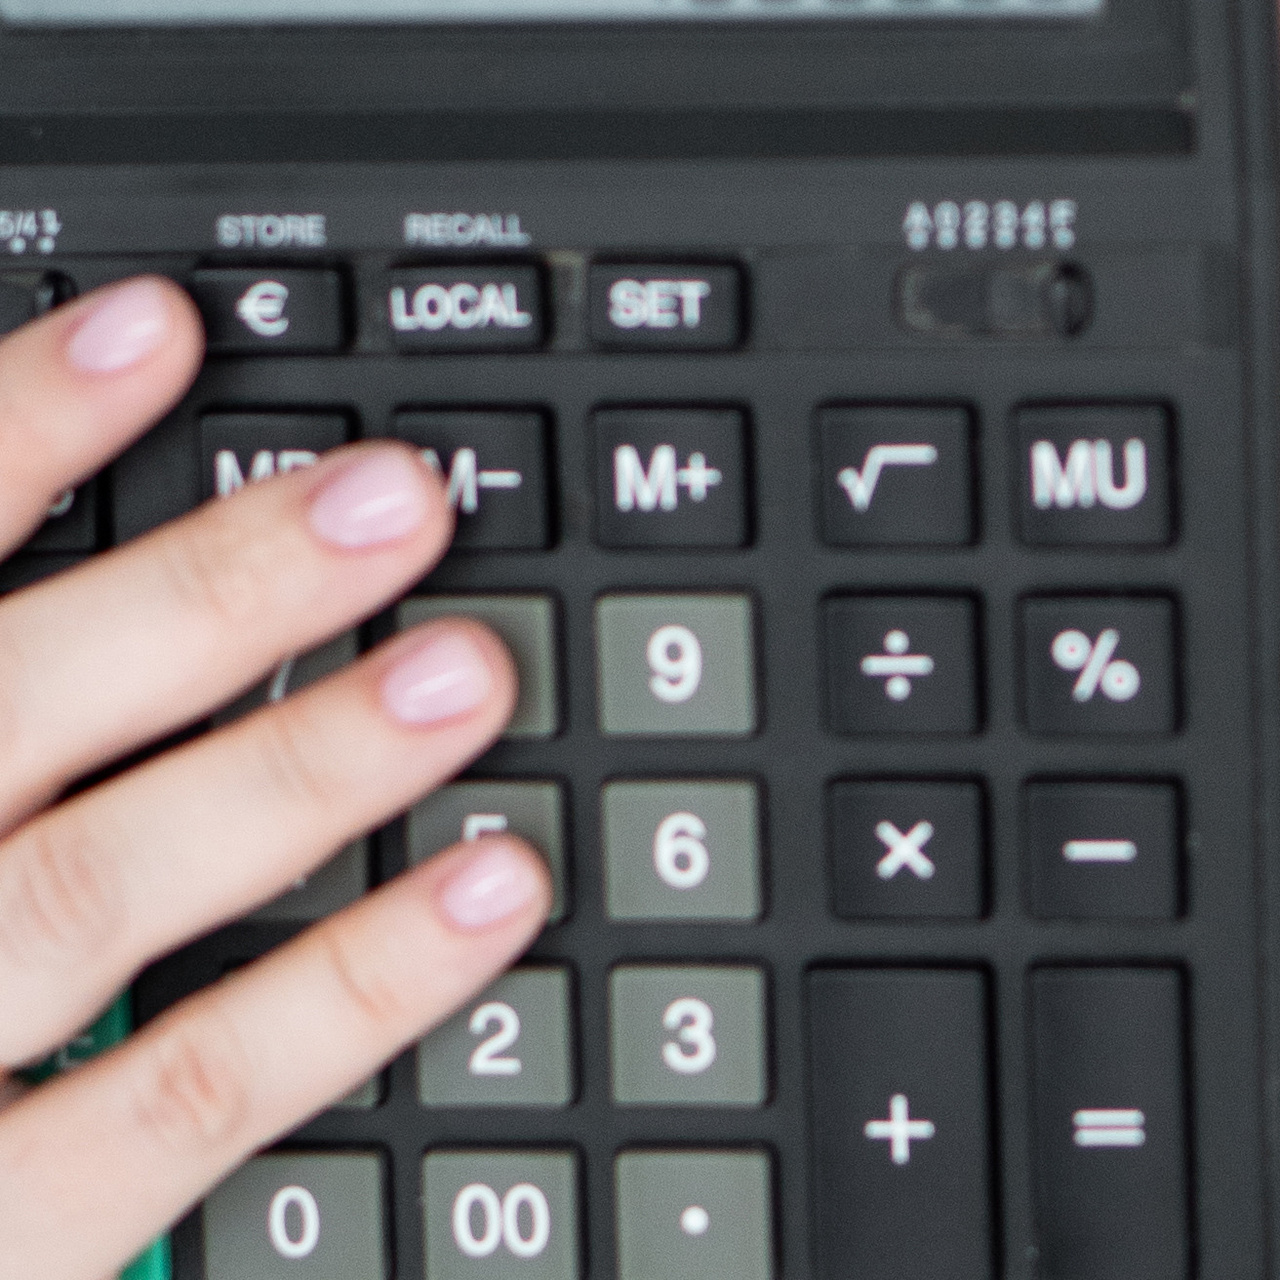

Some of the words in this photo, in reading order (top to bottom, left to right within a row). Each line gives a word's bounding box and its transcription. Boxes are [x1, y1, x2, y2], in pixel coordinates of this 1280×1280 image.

[216, 214, 326, 247] STORE
[403, 213, 530, 246] RECALL
[391, 283, 531, 330] LOCAL
[609, 280, 710, 327] SET
[614, 444, 721, 511] M+
[1031, 439, 1146, 508] MU
[647, 625, 702, 702] 9
[1051, 629, 1140, 701] %
[654, 812, 709, 888] 6
[469, 1003, 521, 1075] 2
[663, 998, 716, 1073] 3
[268, 1185, 320, 1258] 0
[452, 1184, 550, 1258] 00
